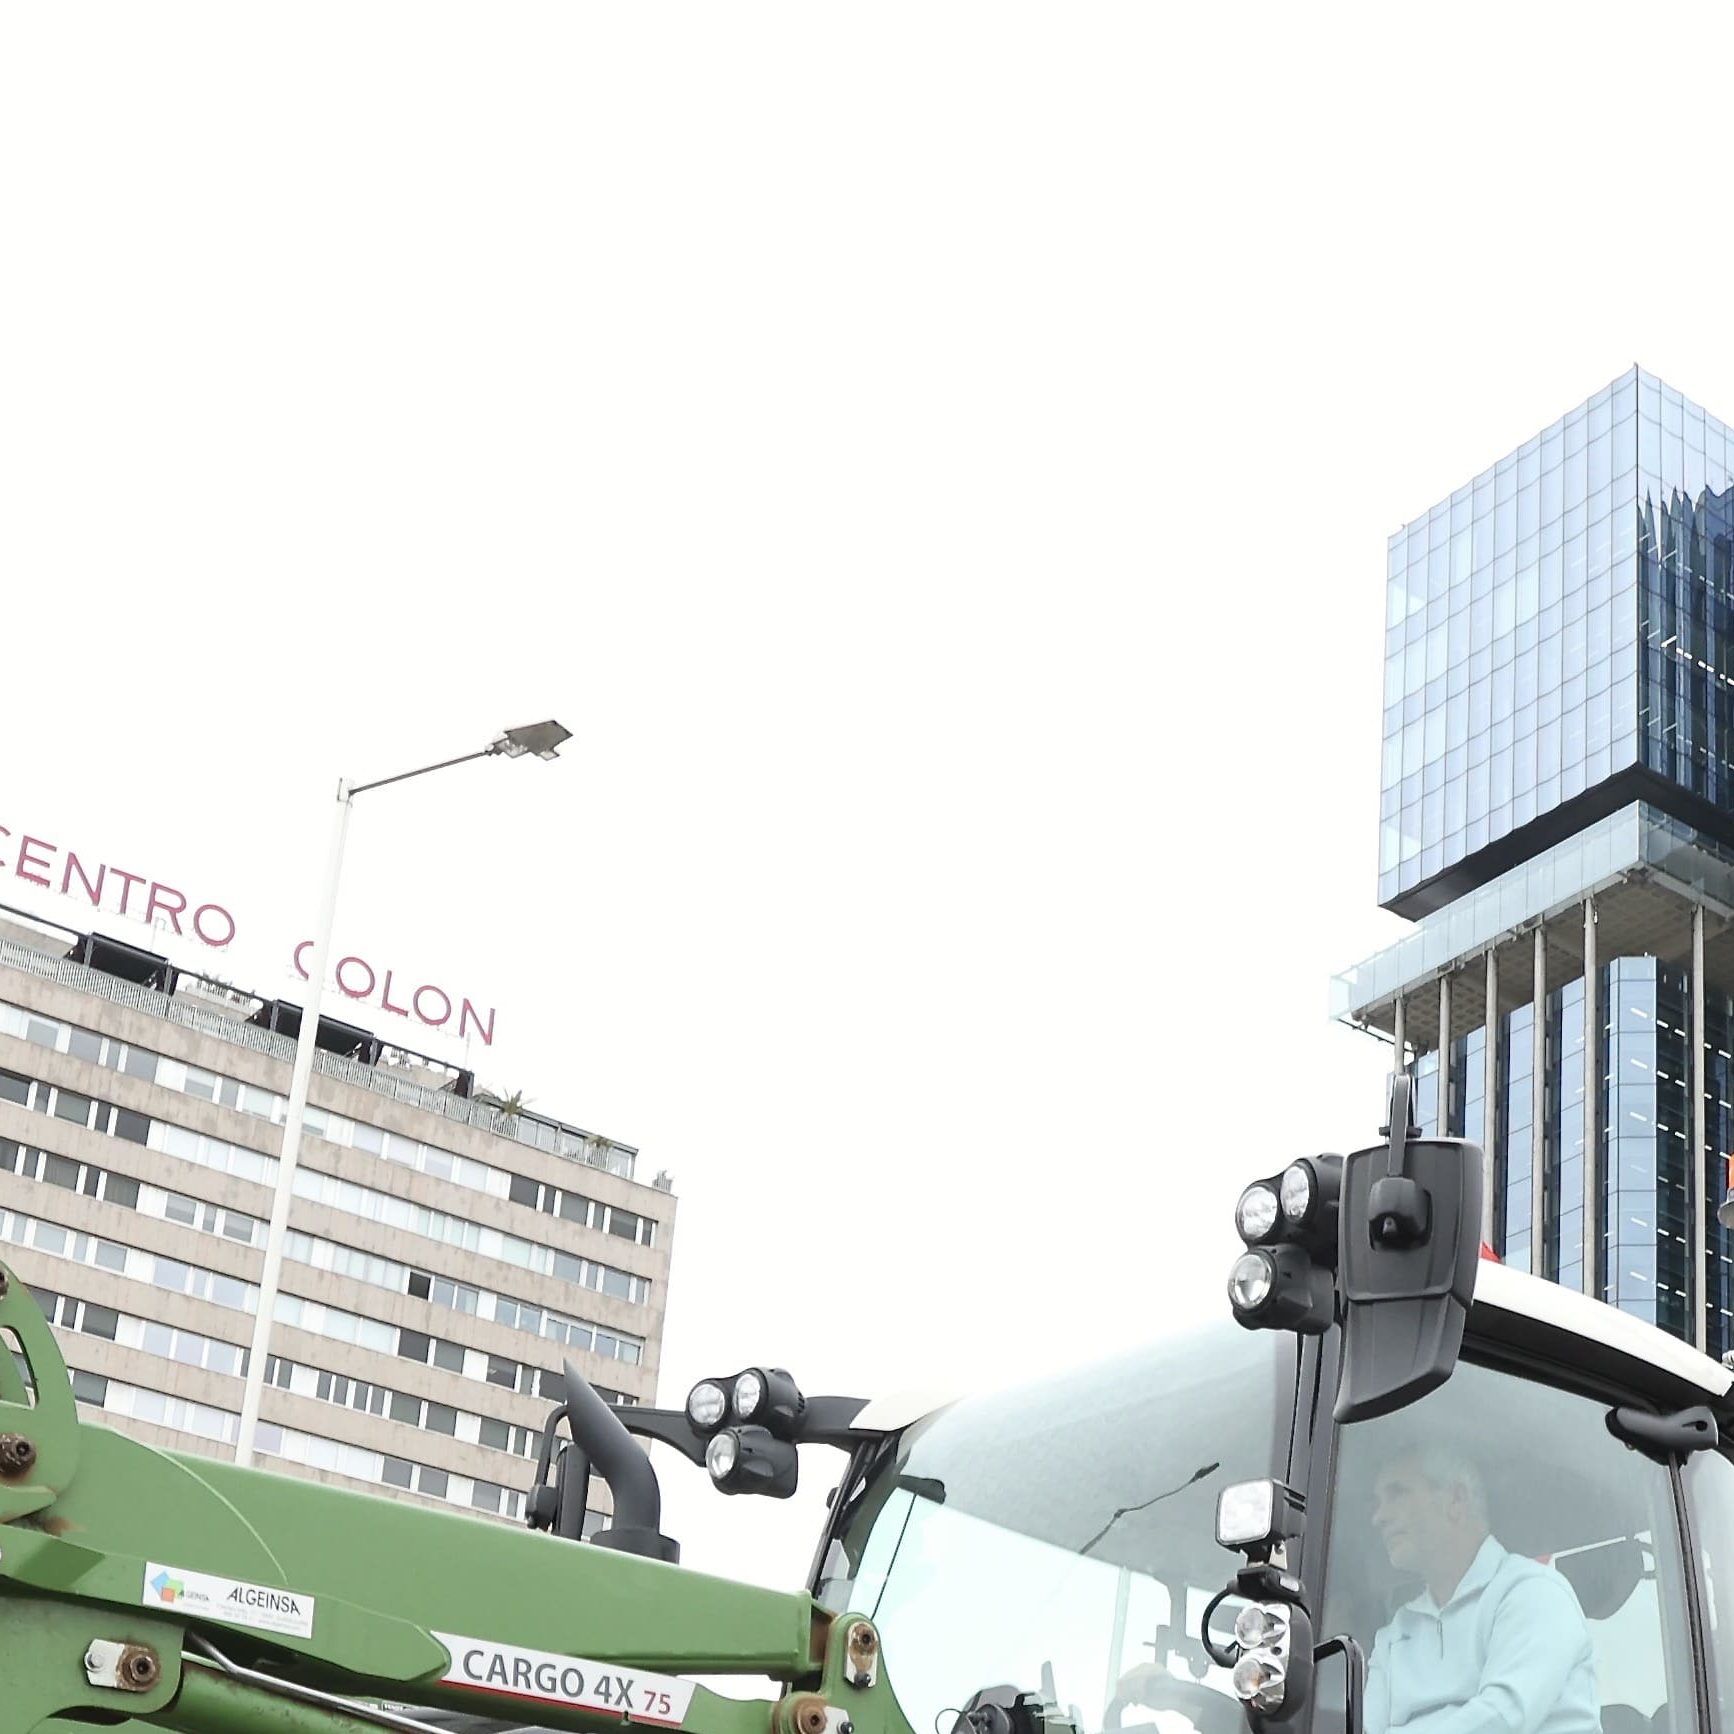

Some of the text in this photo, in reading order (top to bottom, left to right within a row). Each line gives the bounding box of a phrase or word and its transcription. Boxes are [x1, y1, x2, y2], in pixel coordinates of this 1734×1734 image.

[226, 1586, 301, 1616] ALGEINSA
[462, 1649, 671, 1715] CARGO 4X 75
